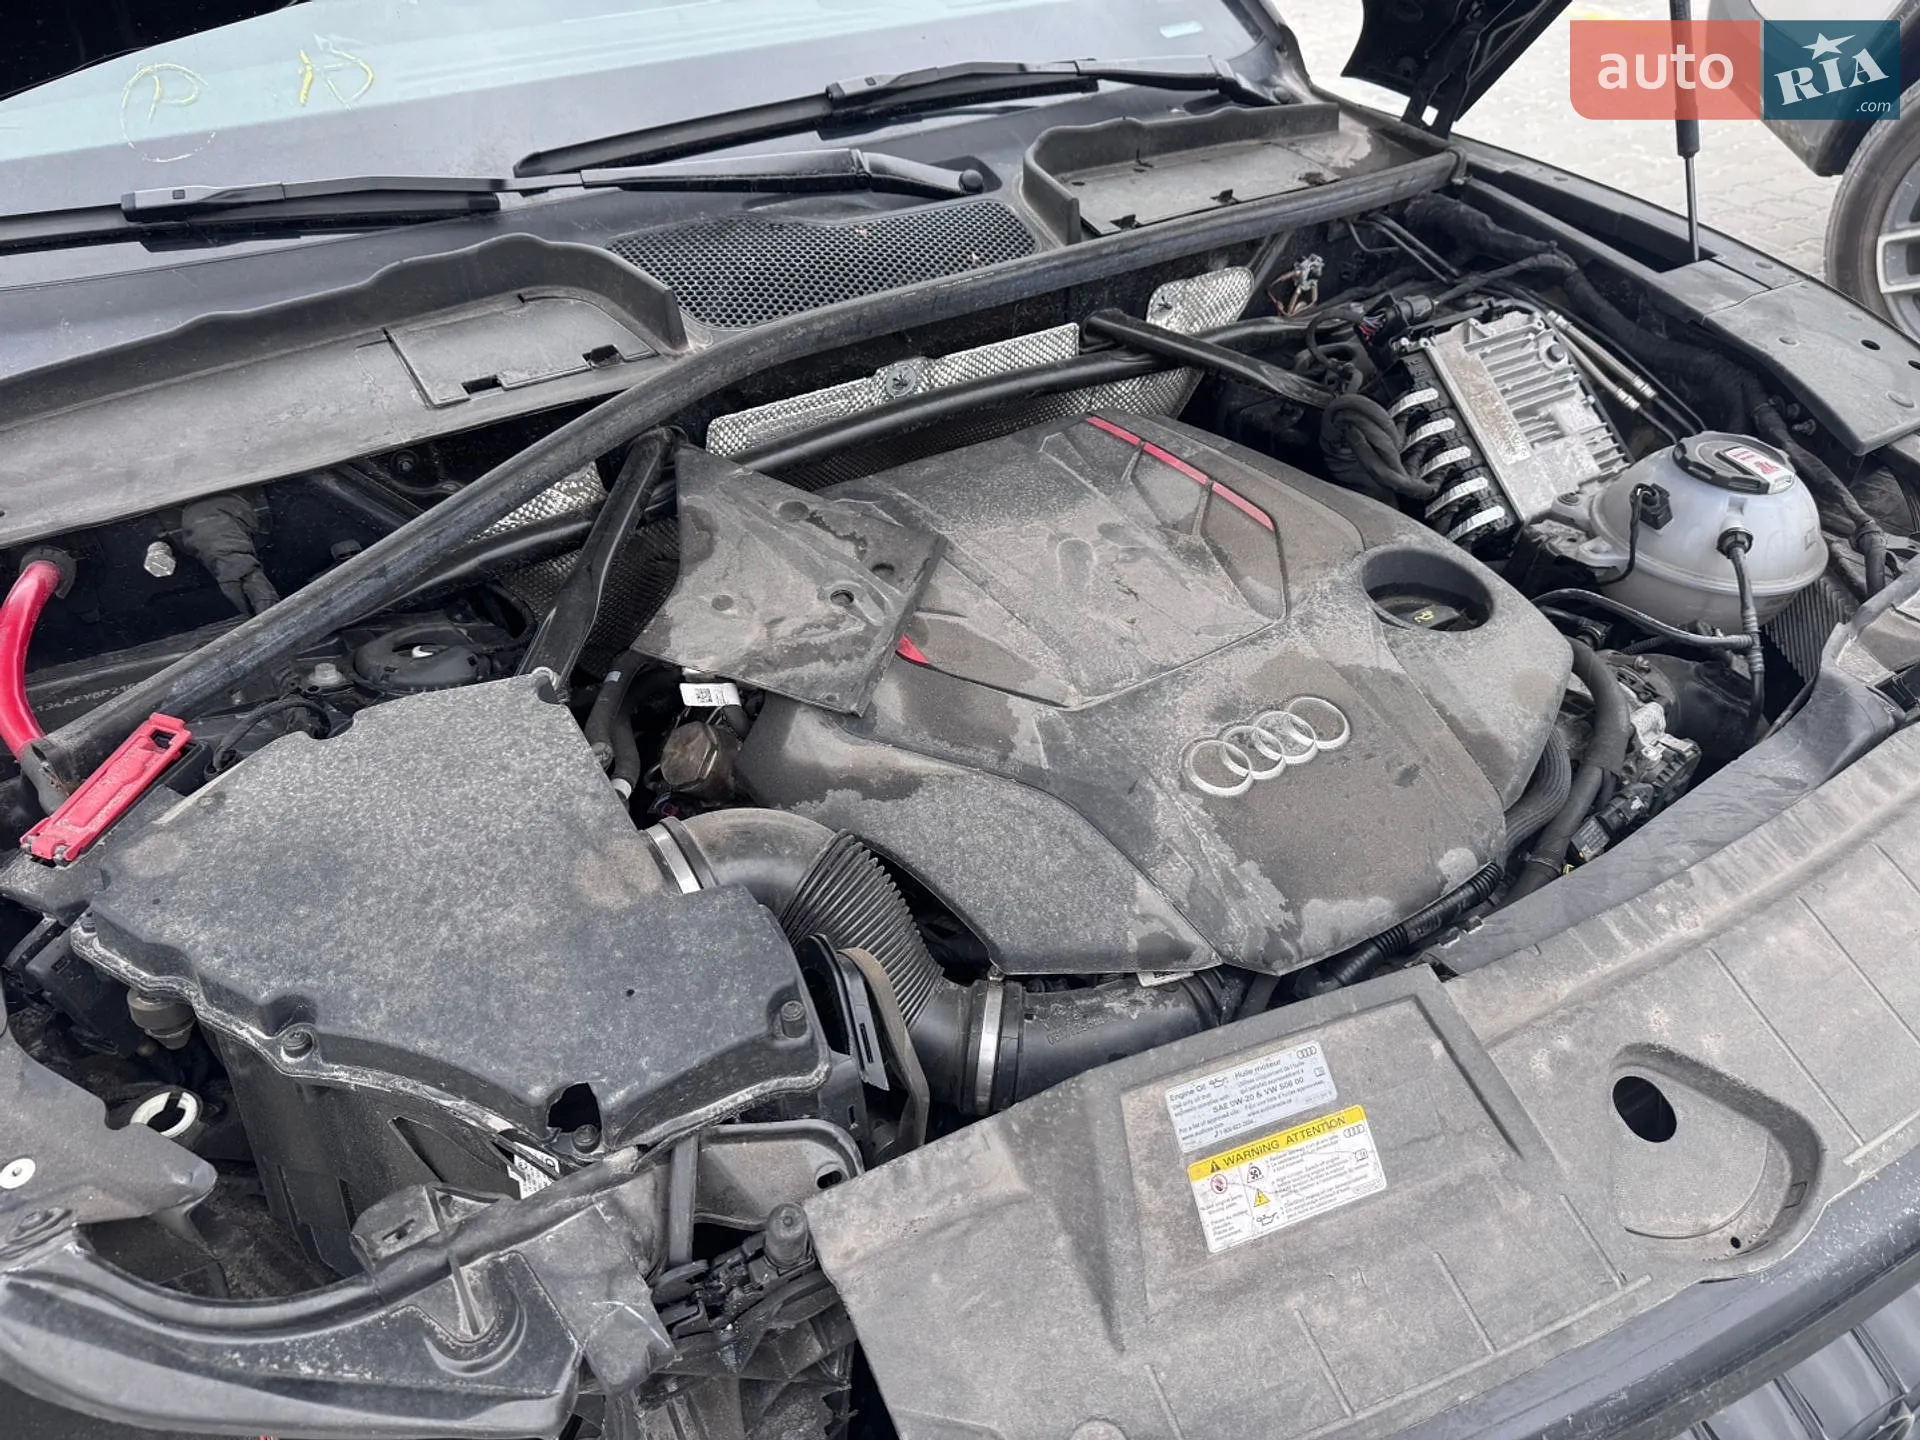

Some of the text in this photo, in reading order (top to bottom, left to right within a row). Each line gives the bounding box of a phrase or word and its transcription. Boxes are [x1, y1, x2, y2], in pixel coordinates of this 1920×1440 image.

[1253, 1059, 1281, 1072] moteur
[1169, 1087, 1195, 1102] Engine
[1195, 1083, 1206, 1092] Oil
[1212, 1102, 1227, 1112] SAE
[1263, 1085, 1277, 1095] VW
[1222, 1139, 1280, 1167] WARNING
[1285, 1115, 1346, 1144] ATTENTION
